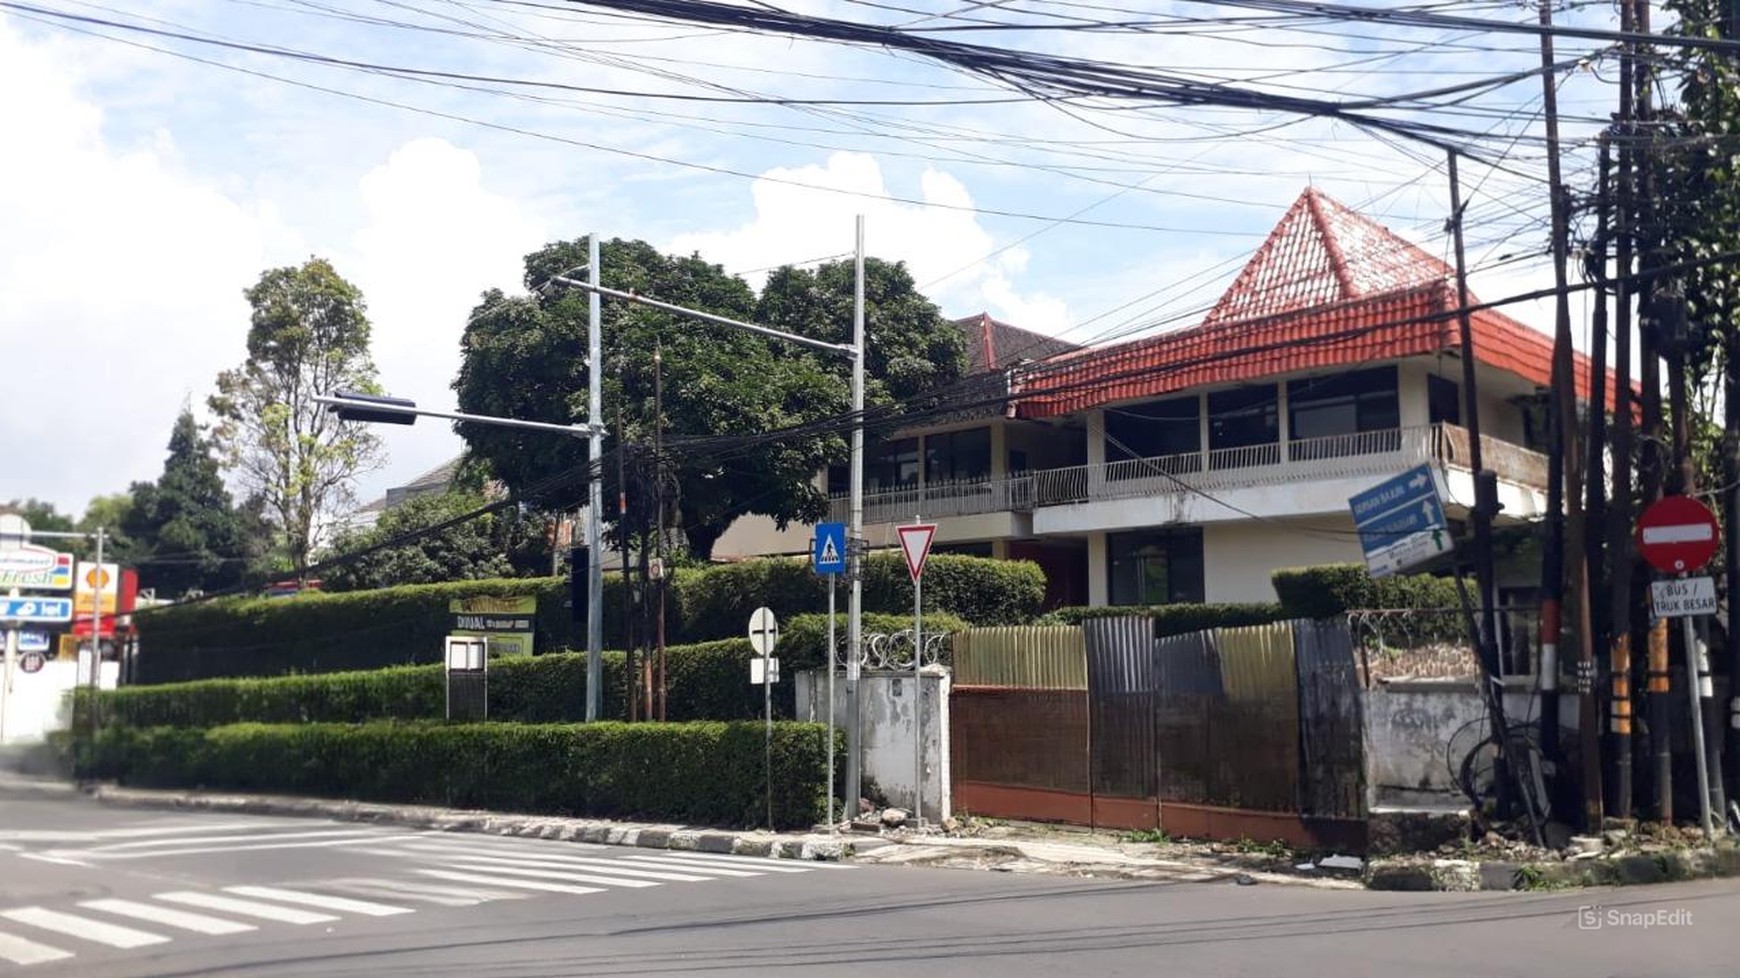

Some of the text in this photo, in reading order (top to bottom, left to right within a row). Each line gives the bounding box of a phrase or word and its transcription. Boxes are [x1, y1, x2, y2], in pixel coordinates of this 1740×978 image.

[1666, 583, 1688, 597] BUS
[1655, 597, 1715, 612] TRUK BESAR
